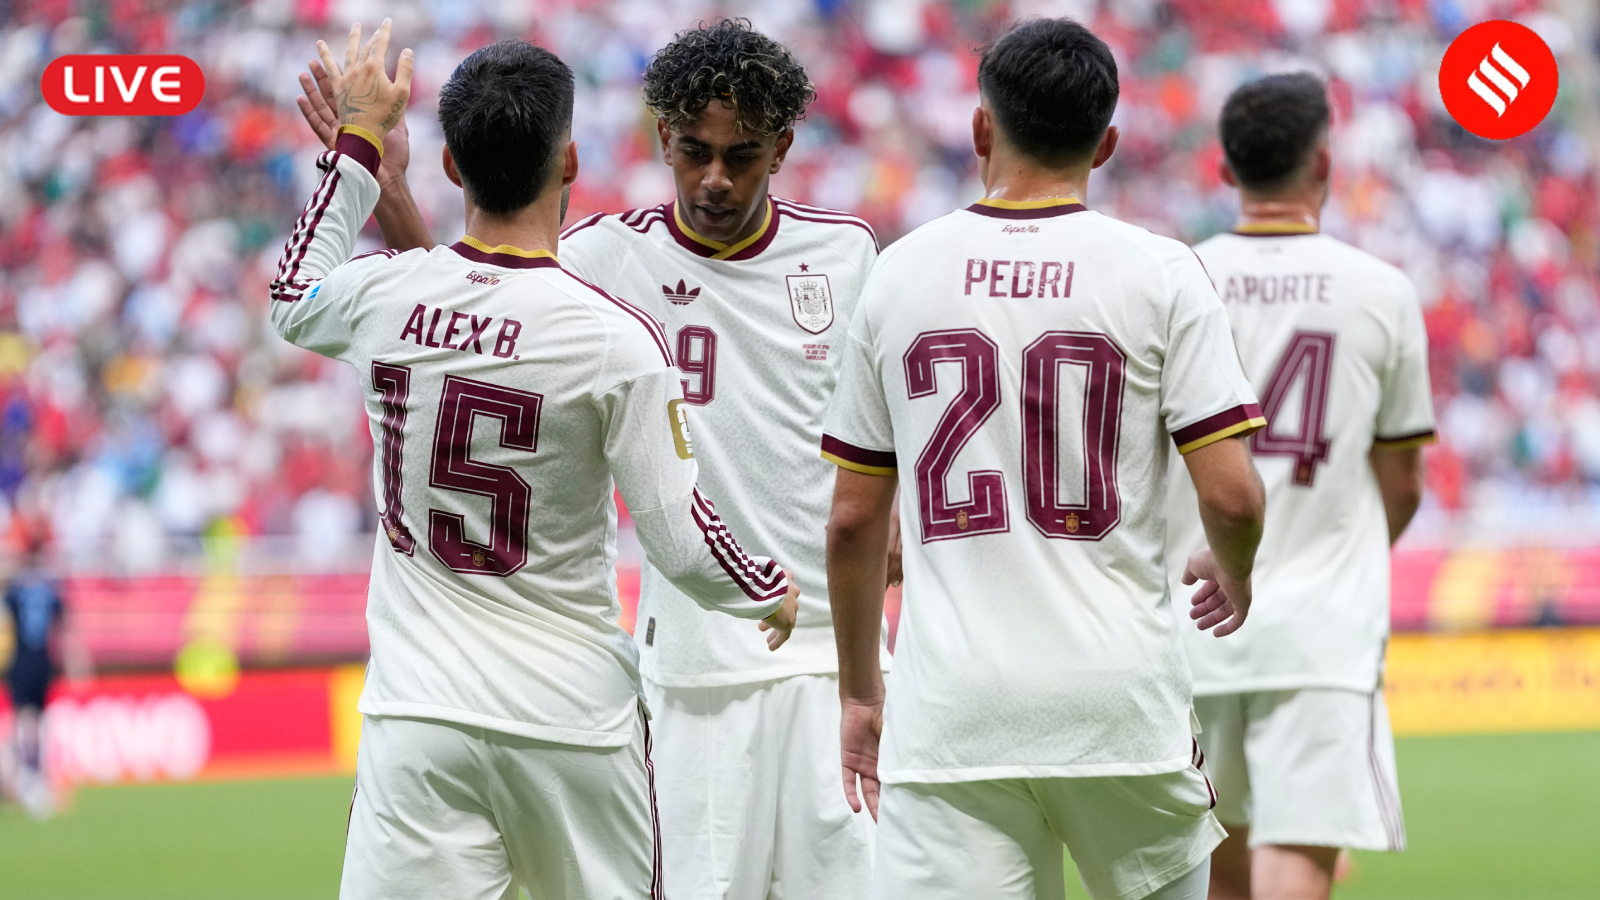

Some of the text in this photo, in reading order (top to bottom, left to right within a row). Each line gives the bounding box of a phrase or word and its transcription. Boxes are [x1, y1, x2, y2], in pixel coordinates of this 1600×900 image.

[964, 258, 1075, 298] PEDRI
[1221, 272, 1334, 305] APORTE
[400, 303, 522, 360] ALEX B.
[660, 323, 718, 406] 9
[903, 328, 1128, 544] 20
[1250, 329, 1337, 487] 4
[371, 360, 544, 578] 15
